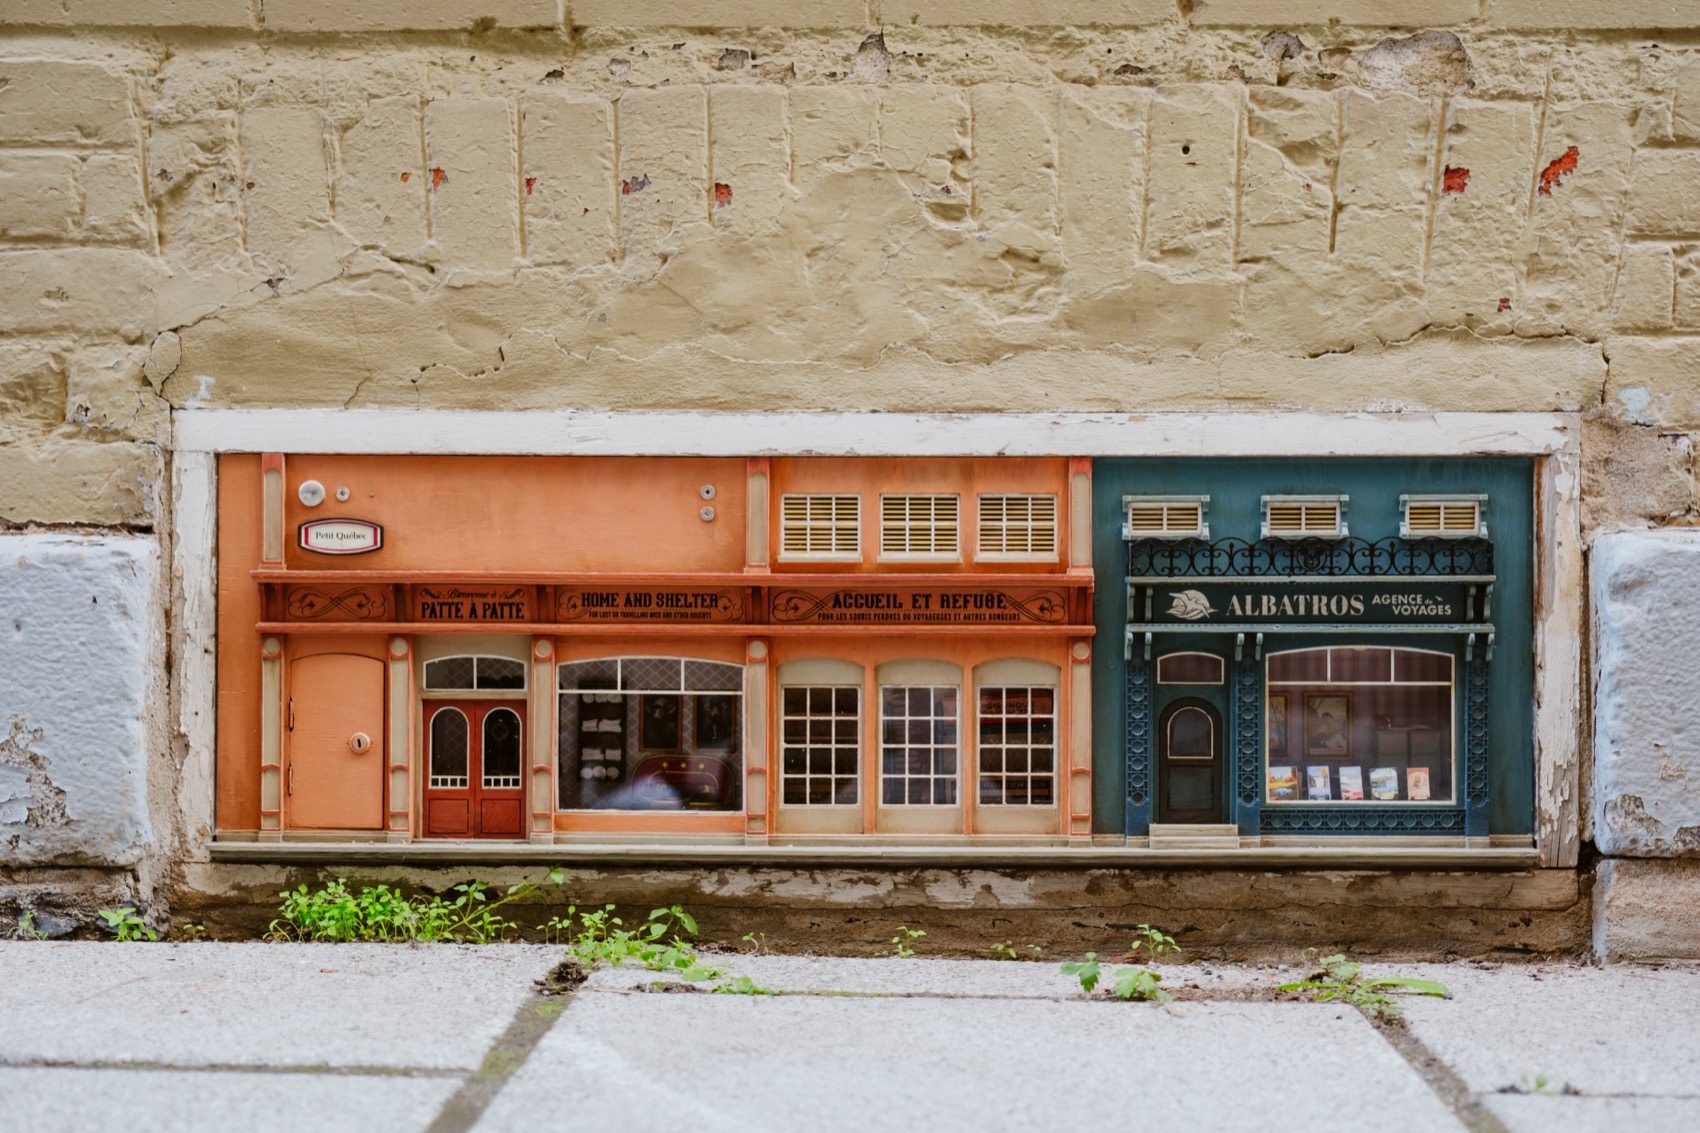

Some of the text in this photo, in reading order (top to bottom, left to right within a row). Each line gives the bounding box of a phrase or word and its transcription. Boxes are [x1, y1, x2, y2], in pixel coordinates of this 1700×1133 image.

[315, 531, 367, 541] Petit Québec
[443, 587, 489, 599] Bienvenue
[581, 592, 718, 609] HOME AND SHELTER
[832, 592, 1007, 609] ACCUEIL ET REFUGE
[1226, 594, 1365, 616] ALBATROS
[1372, 594, 1423, 605] AGENCE
[421, 602, 464, 619] PATTE
[482, 602, 525, 619] PATTE
[589, 611, 598, 619] FOR
[599, 611, 611, 619] LOST
[612, 611, 619, 619] OR
[620, 611, 648, 619] TRAVELLING
[649, 611, 661, 619] MICE
[662, 611, 672, 619] AND
[674, 611, 688, 619] OTHER
[1392, 605, 1452, 616] VOYAGES
[818, 612, 1021, 621] POUR LES SOURIS PERDUES OU VOYAGEUSES ET AUTRES RONGEURS
[981, 700, 1035, 710] POISNOU
